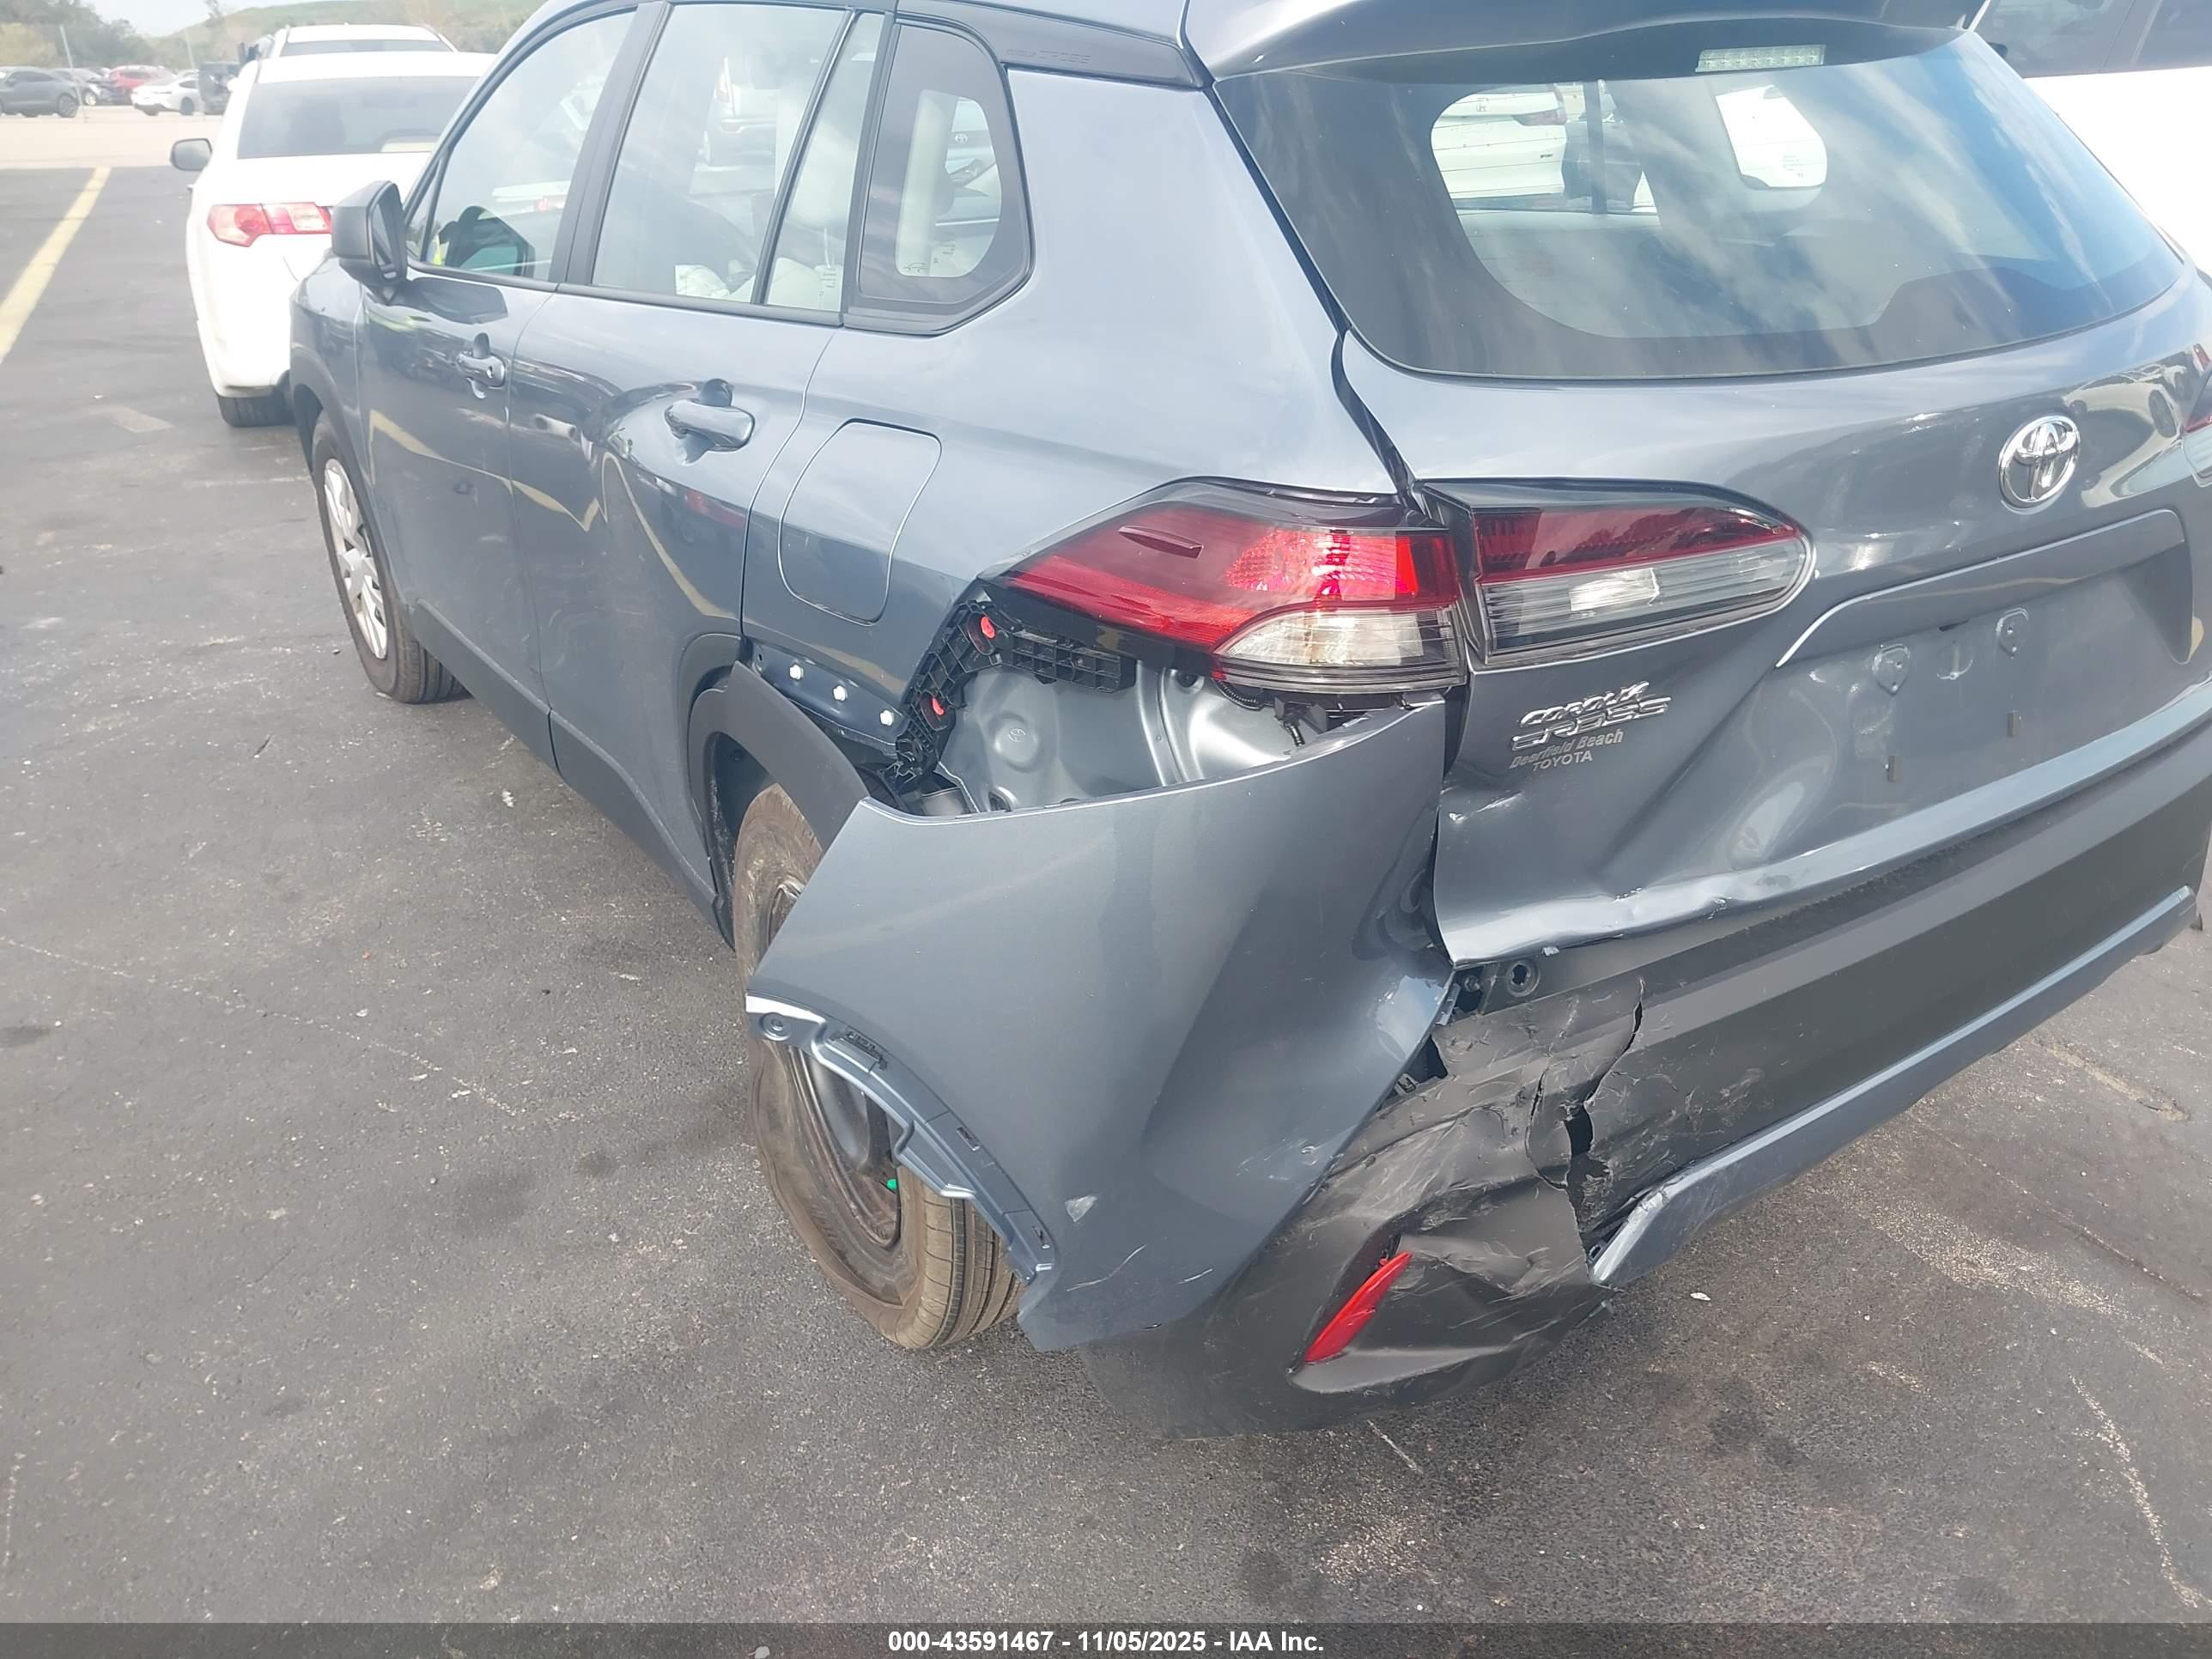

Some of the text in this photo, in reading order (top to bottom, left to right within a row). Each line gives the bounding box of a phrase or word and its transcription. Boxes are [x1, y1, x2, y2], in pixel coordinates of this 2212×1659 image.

[1510, 728, 1625, 769] Deerfield Beach
[1533, 750, 1594, 772] TOYOTA
